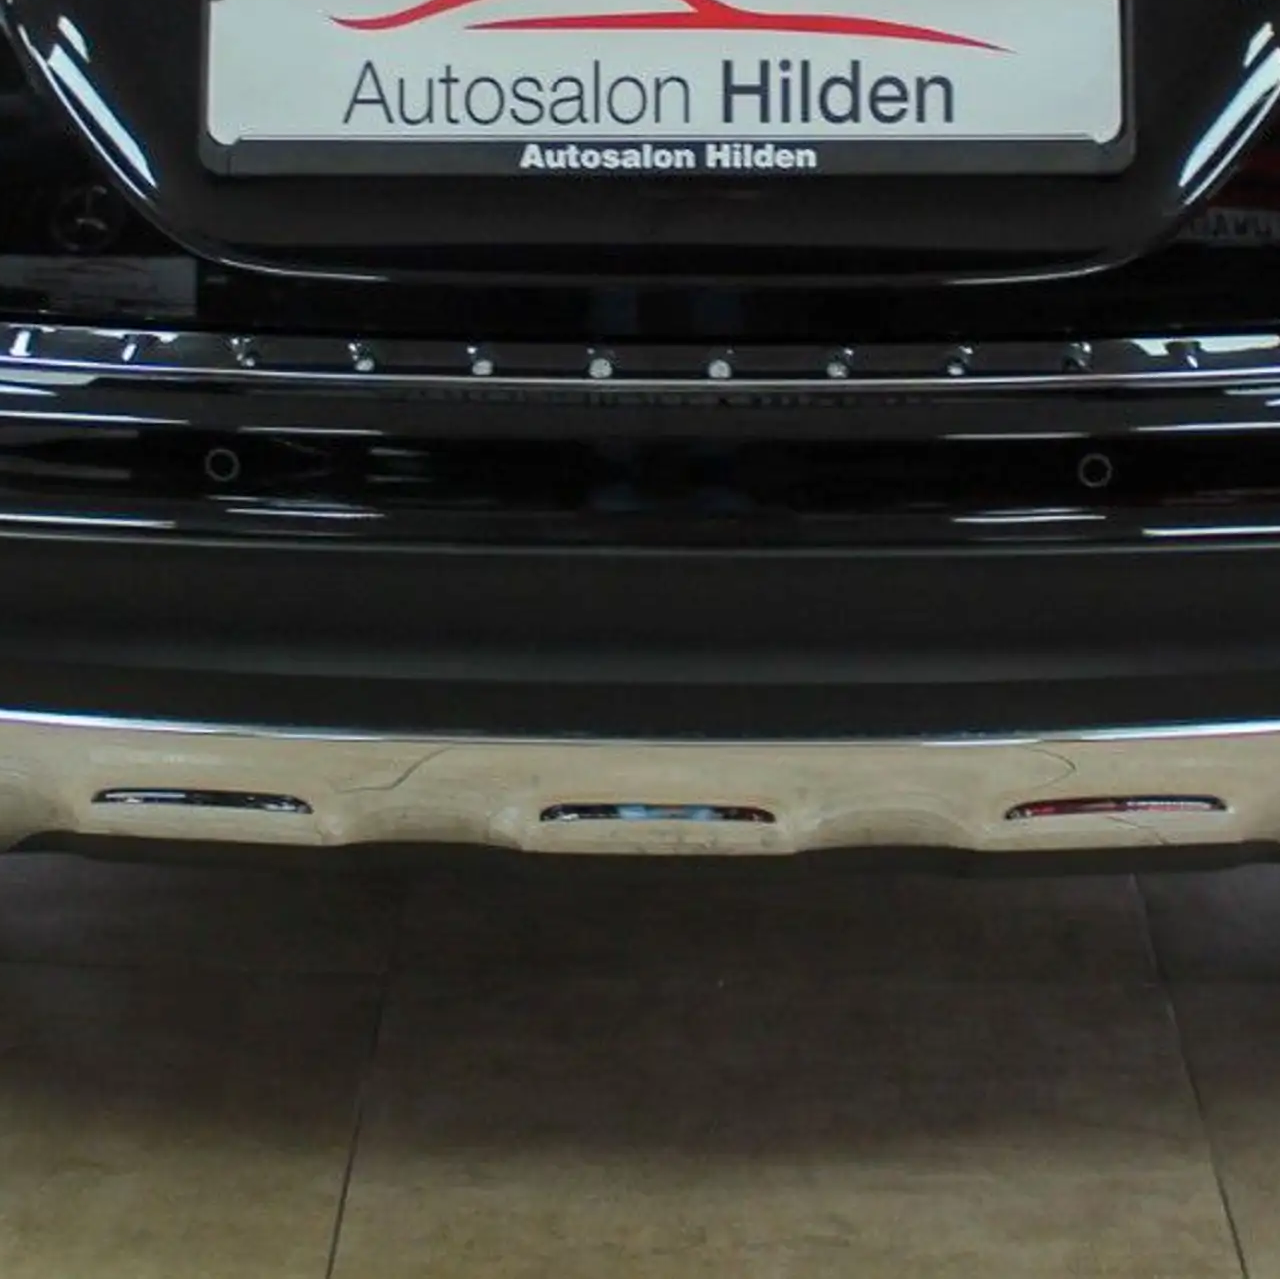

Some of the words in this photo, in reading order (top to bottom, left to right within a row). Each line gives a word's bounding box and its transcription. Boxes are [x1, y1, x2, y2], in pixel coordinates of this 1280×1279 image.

[342, 59, 691, 125] Autosalon
[722, 58, 954, 125] Hilden
[519, 143, 696, 170] Autosalon
[705, 143, 818, 170] Hilden
